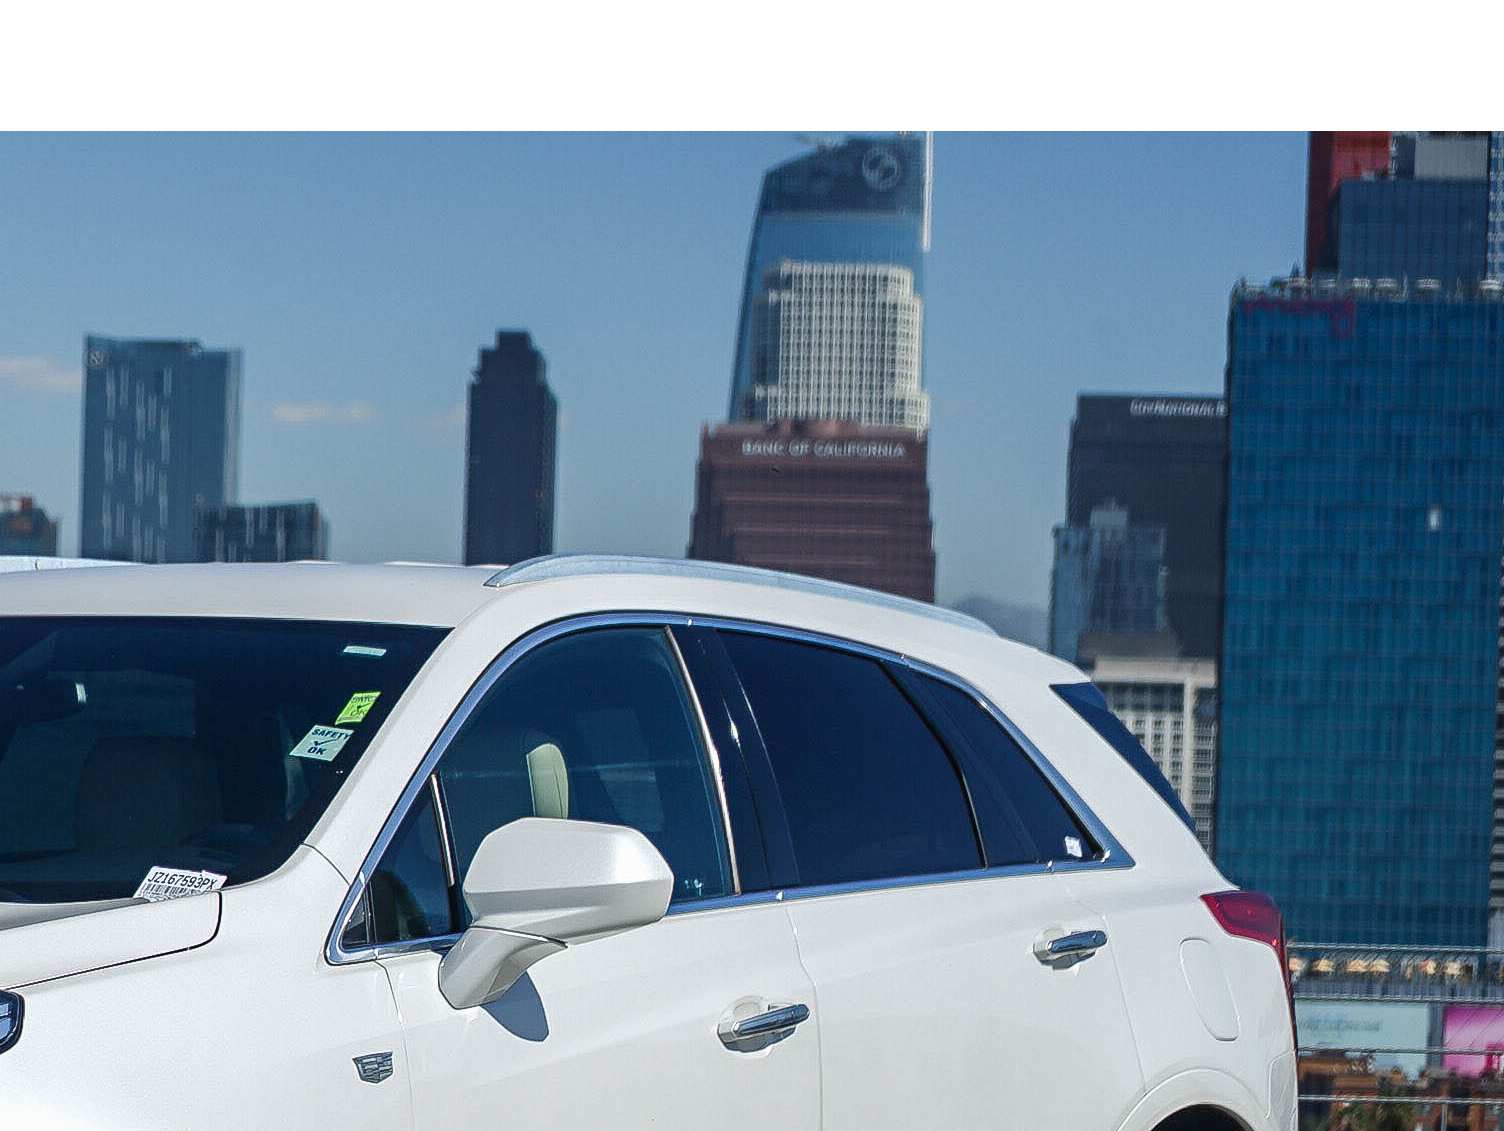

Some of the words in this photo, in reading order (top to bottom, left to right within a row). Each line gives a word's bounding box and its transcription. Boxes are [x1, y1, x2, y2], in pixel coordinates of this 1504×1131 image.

[789, 440, 809, 456] OF
[814, 441, 905, 457] CALIFORNIA
[312, 728, 350, 740] SAFETY
[307, 746, 328, 756] OK
